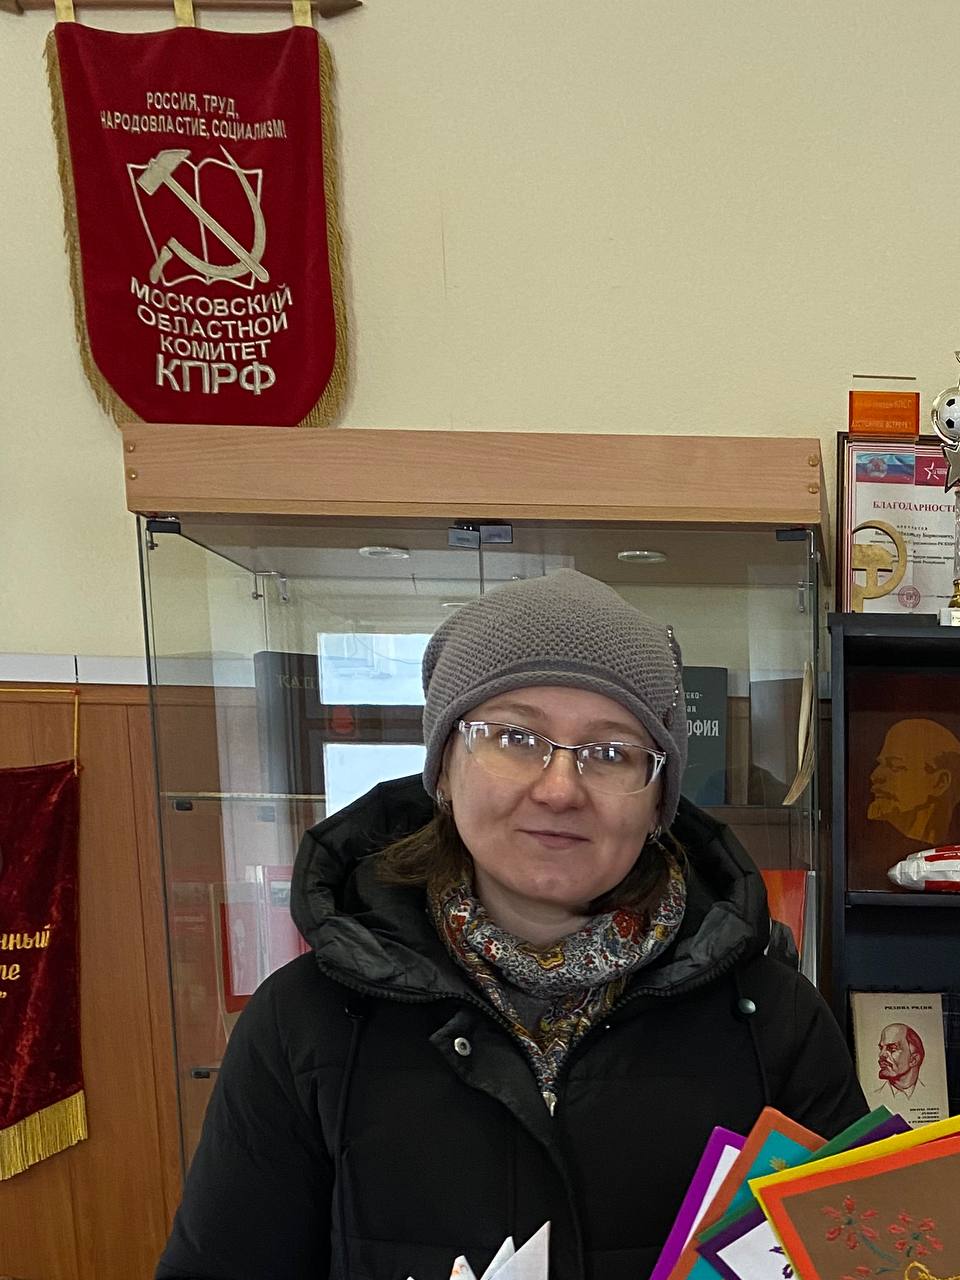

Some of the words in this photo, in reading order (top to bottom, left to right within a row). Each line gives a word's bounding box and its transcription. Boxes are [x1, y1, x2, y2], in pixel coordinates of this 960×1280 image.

[146, 92, 200, 115] РОССИЯ,
[203, 94, 240, 119] ТРУД,
[100, 110, 210, 139] НАРОДОВЛАСТИЕ,
[212, 119, 287, 141] СОЦИАЛИЗМ!
[130, 277, 293, 316] МОСКОВСКИЙ
[137, 304, 288, 337] ОБЛАСТНОЙ
[160, 334, 271, 361] КОМИТЕТ
[155, 353, 276, 395] КПРФ
[687, 719, 719, 737] ОФИЯ
